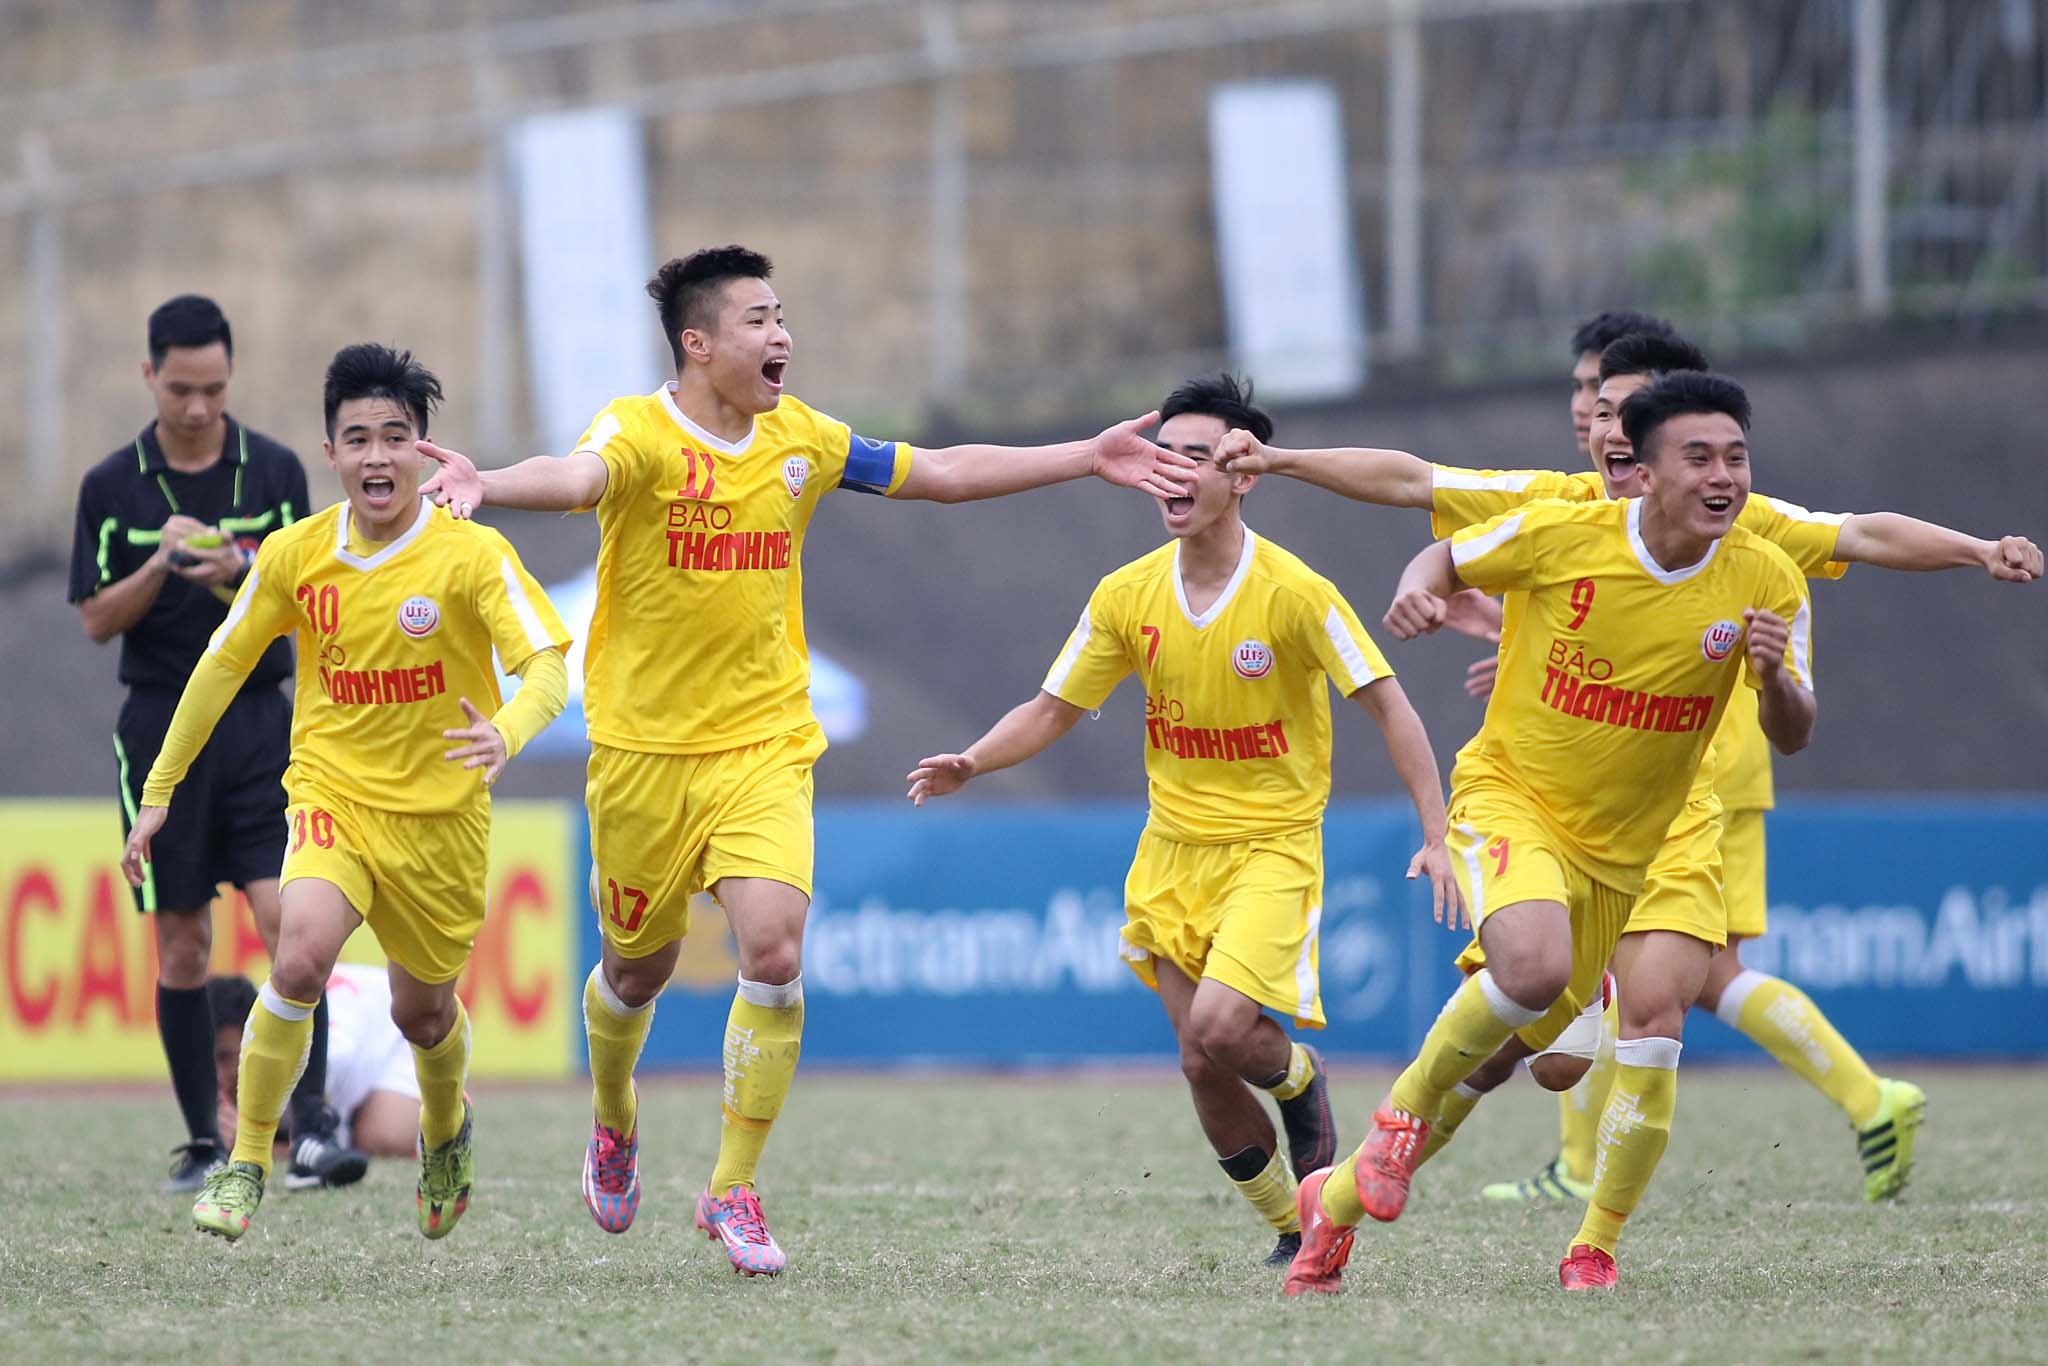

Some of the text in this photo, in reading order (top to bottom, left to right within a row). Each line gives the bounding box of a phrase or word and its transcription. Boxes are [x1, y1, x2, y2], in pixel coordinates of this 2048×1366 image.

[296, 584, 340, 635] 30
[1567, 577, 1596, 631] 9
[1141, 625, 1160, 671] 7
[608, 878, 649, 931] 17
